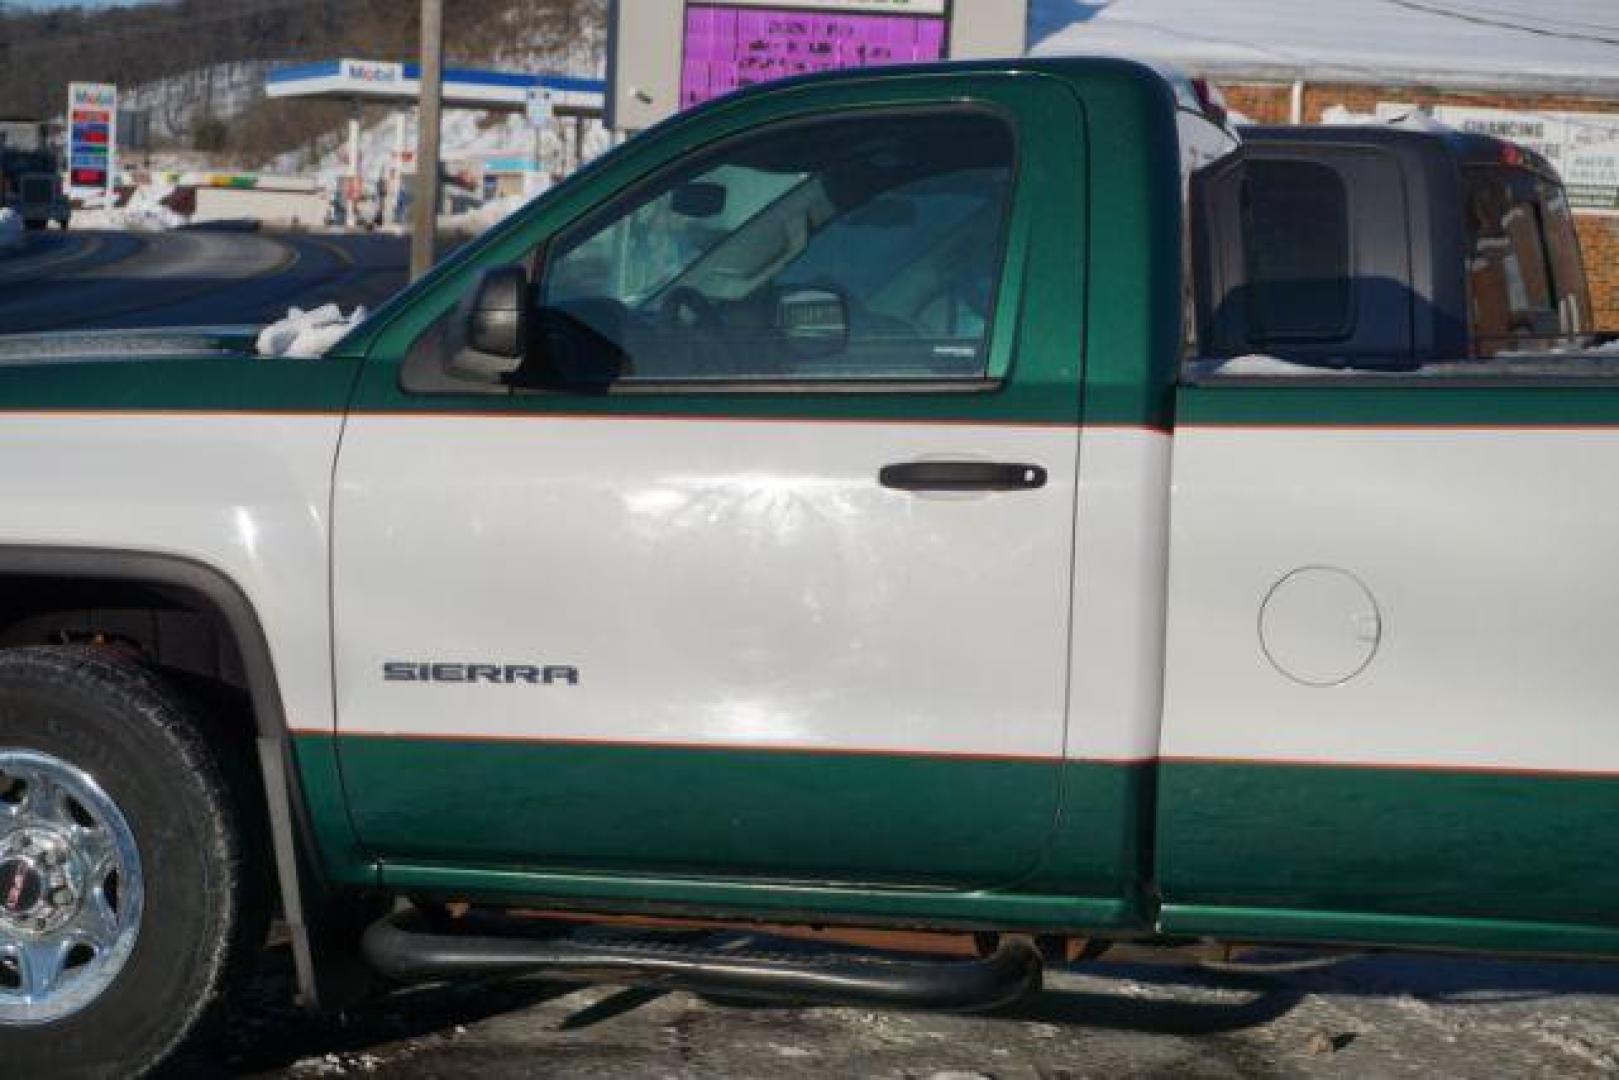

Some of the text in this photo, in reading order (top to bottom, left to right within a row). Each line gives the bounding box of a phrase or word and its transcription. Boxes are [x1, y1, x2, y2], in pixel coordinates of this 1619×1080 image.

[348, 64, 395, 81] Mobil
[75, 88, 115, 105] Mobil
[383, 662, 578, 684] SIERRA
